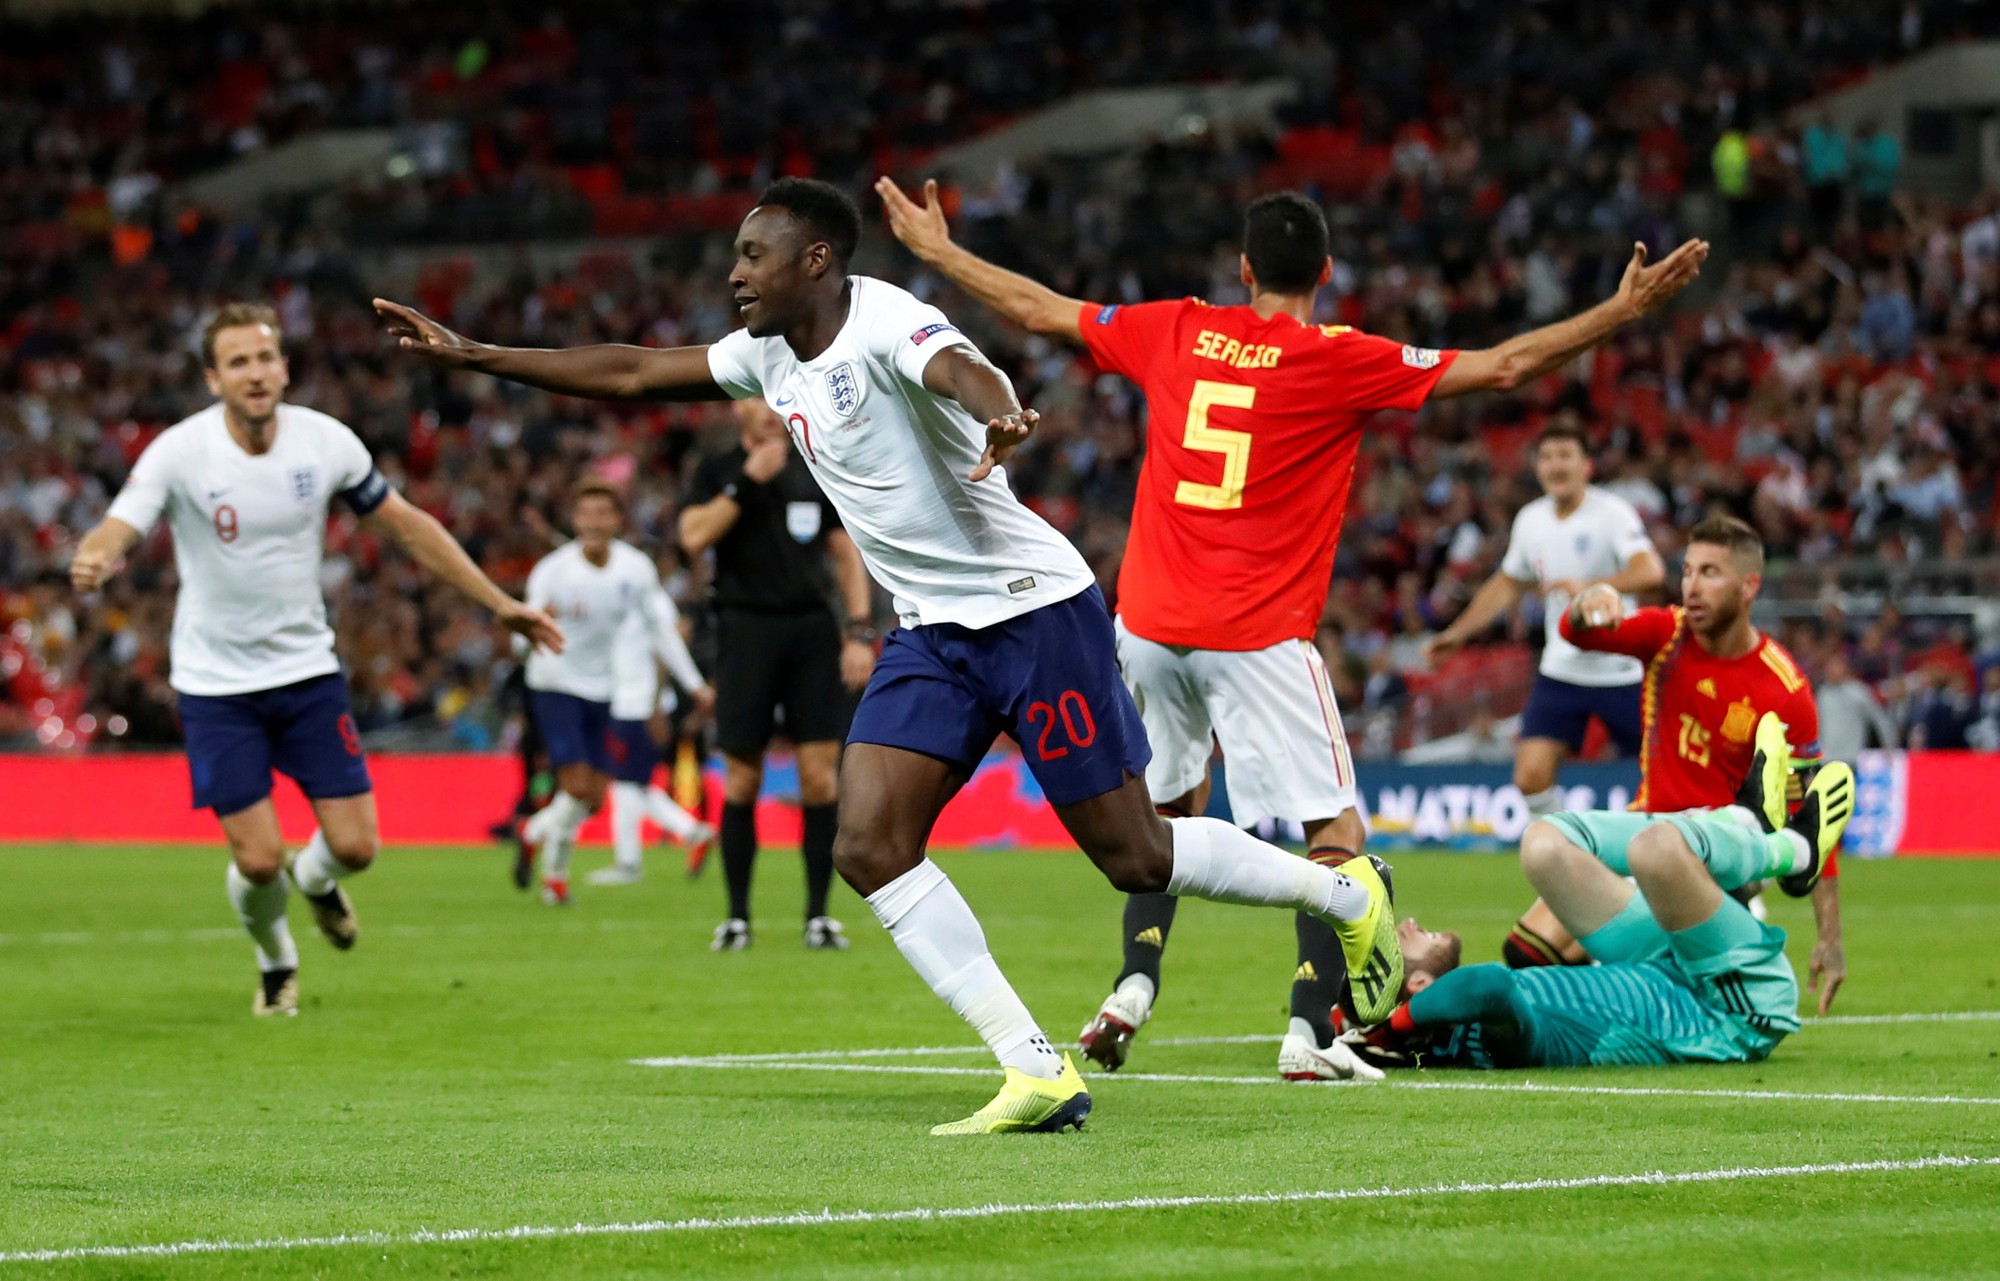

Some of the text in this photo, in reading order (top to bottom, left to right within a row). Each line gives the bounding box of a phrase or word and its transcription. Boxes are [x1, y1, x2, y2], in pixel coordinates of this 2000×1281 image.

[1192, 329, 1283, 369] SERGIO
[788, 412, 817, 466] 0
[1174, 379, 1256, 510] 5
[213, 504, 239, 543] 9
[1026, 689, 1097, 761] 20
[1679, 712, 1711, 768] 15
